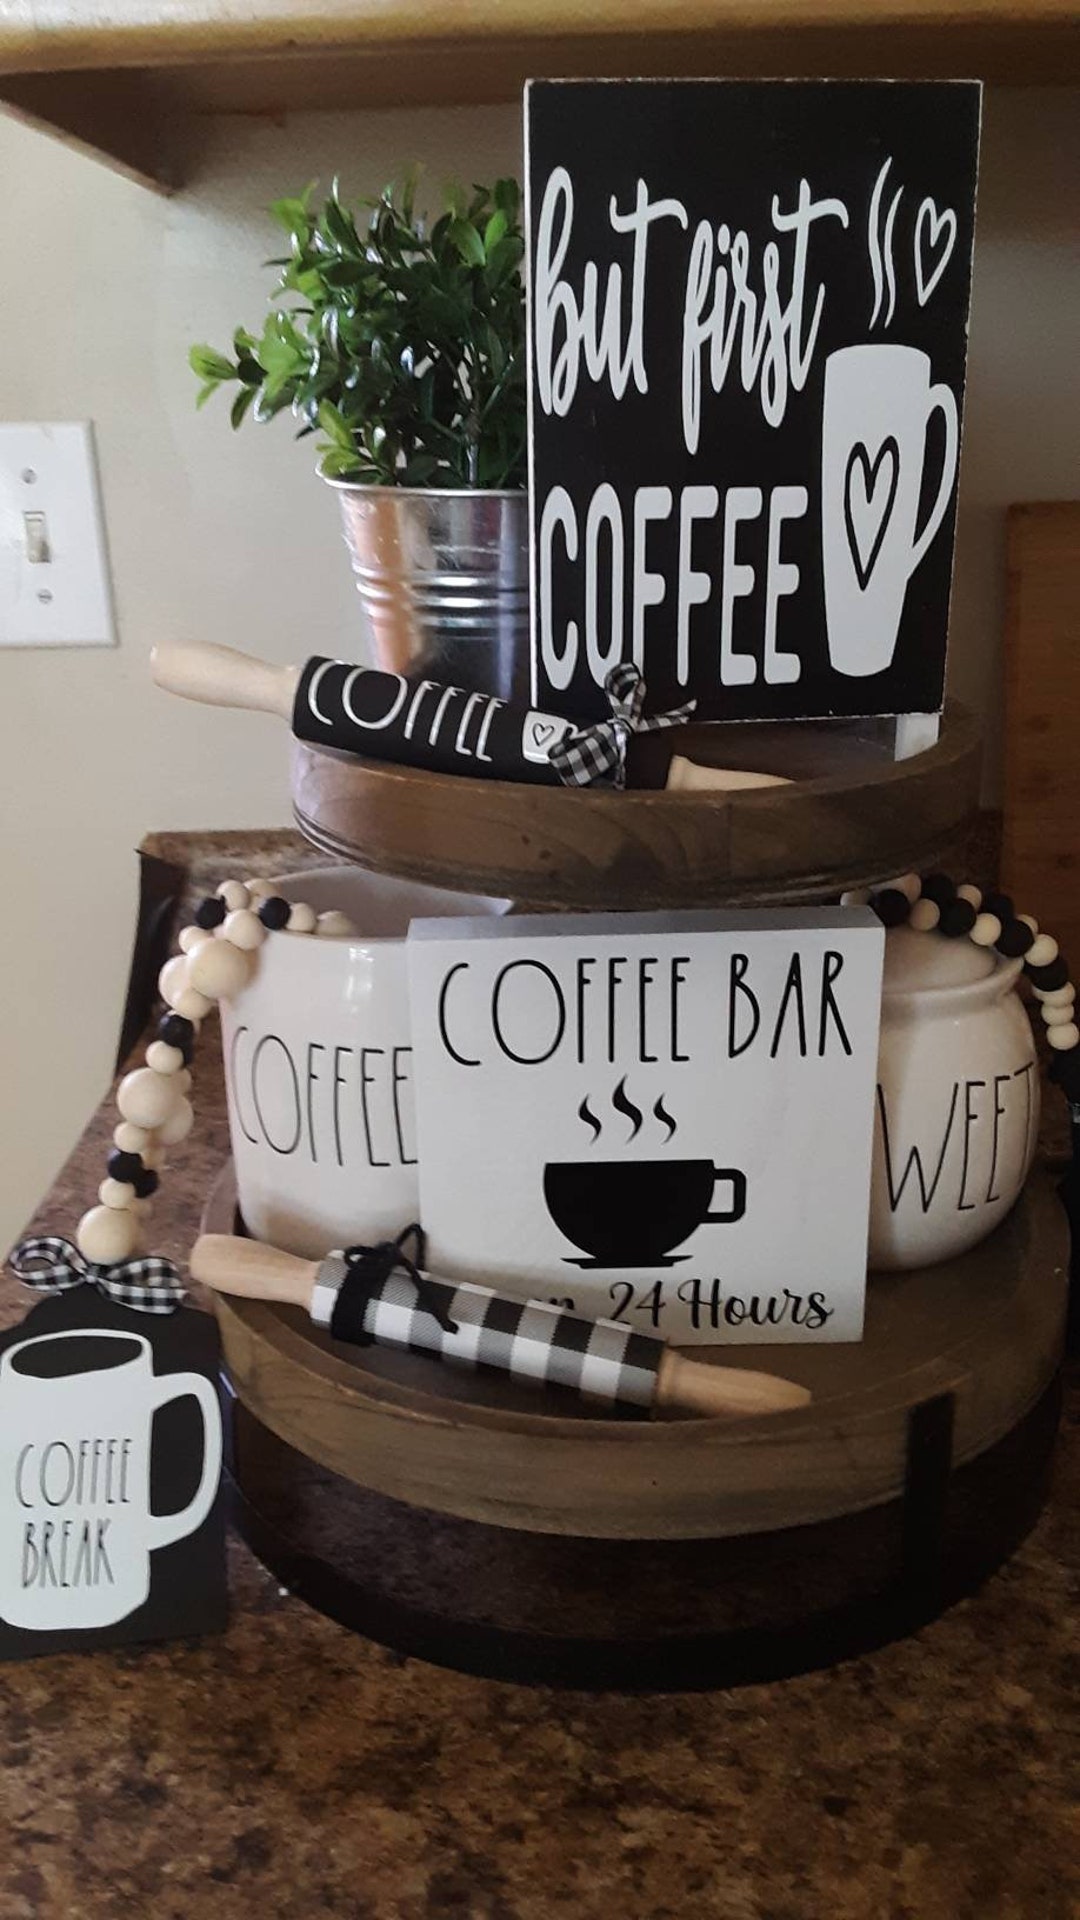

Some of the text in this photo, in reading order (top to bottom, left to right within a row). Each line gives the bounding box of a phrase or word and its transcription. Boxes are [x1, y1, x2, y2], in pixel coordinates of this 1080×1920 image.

[536, 166, 849, 454] but first
[540, 482, 808, 691] COFFEE
[308, 658, 508, 762] COFFEE
[438, 950, 853, 1066] COFFEE BAR
[230, 1025, 419, 1167] COFFEE
[608, 1278, 835, 1329] 24 Hours
[15, 1438, 134, 1508] COFFEE
[22, 1518, 115, 1589] BREAK
